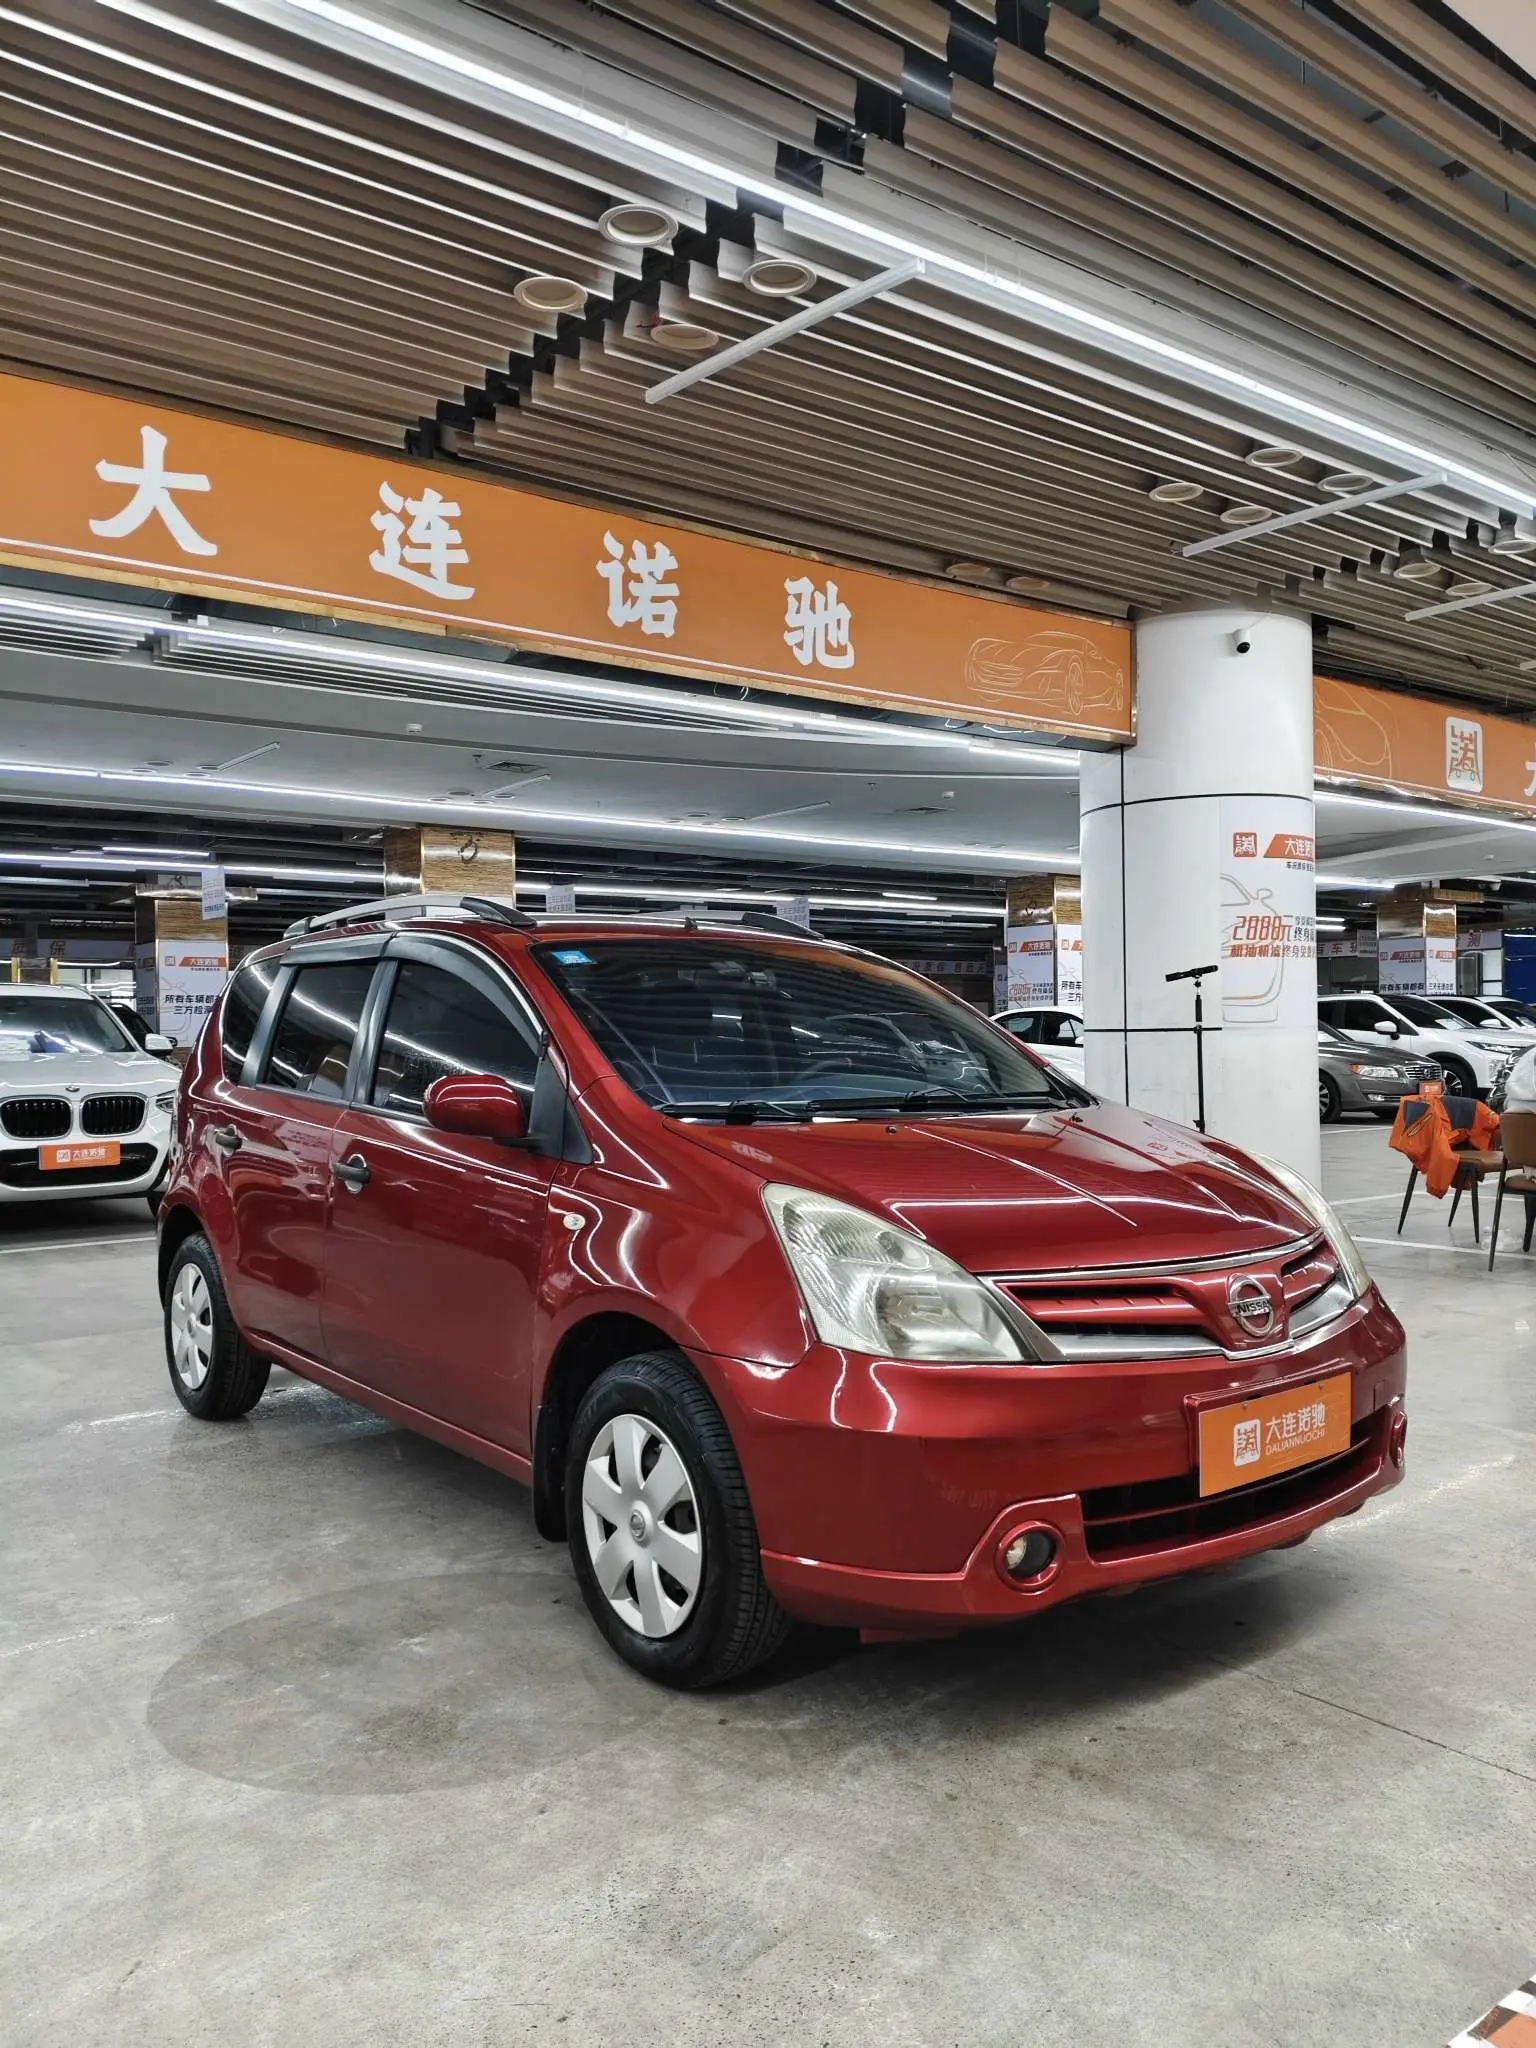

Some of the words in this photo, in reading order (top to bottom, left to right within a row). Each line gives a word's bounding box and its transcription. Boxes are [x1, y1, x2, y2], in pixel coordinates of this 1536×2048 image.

[89, 425, 855, 669] 大连诺驰
[165, 994, 218, 1005] 所有车辆都
[1266, 1402, 1326, 1444] 大连诺驰
